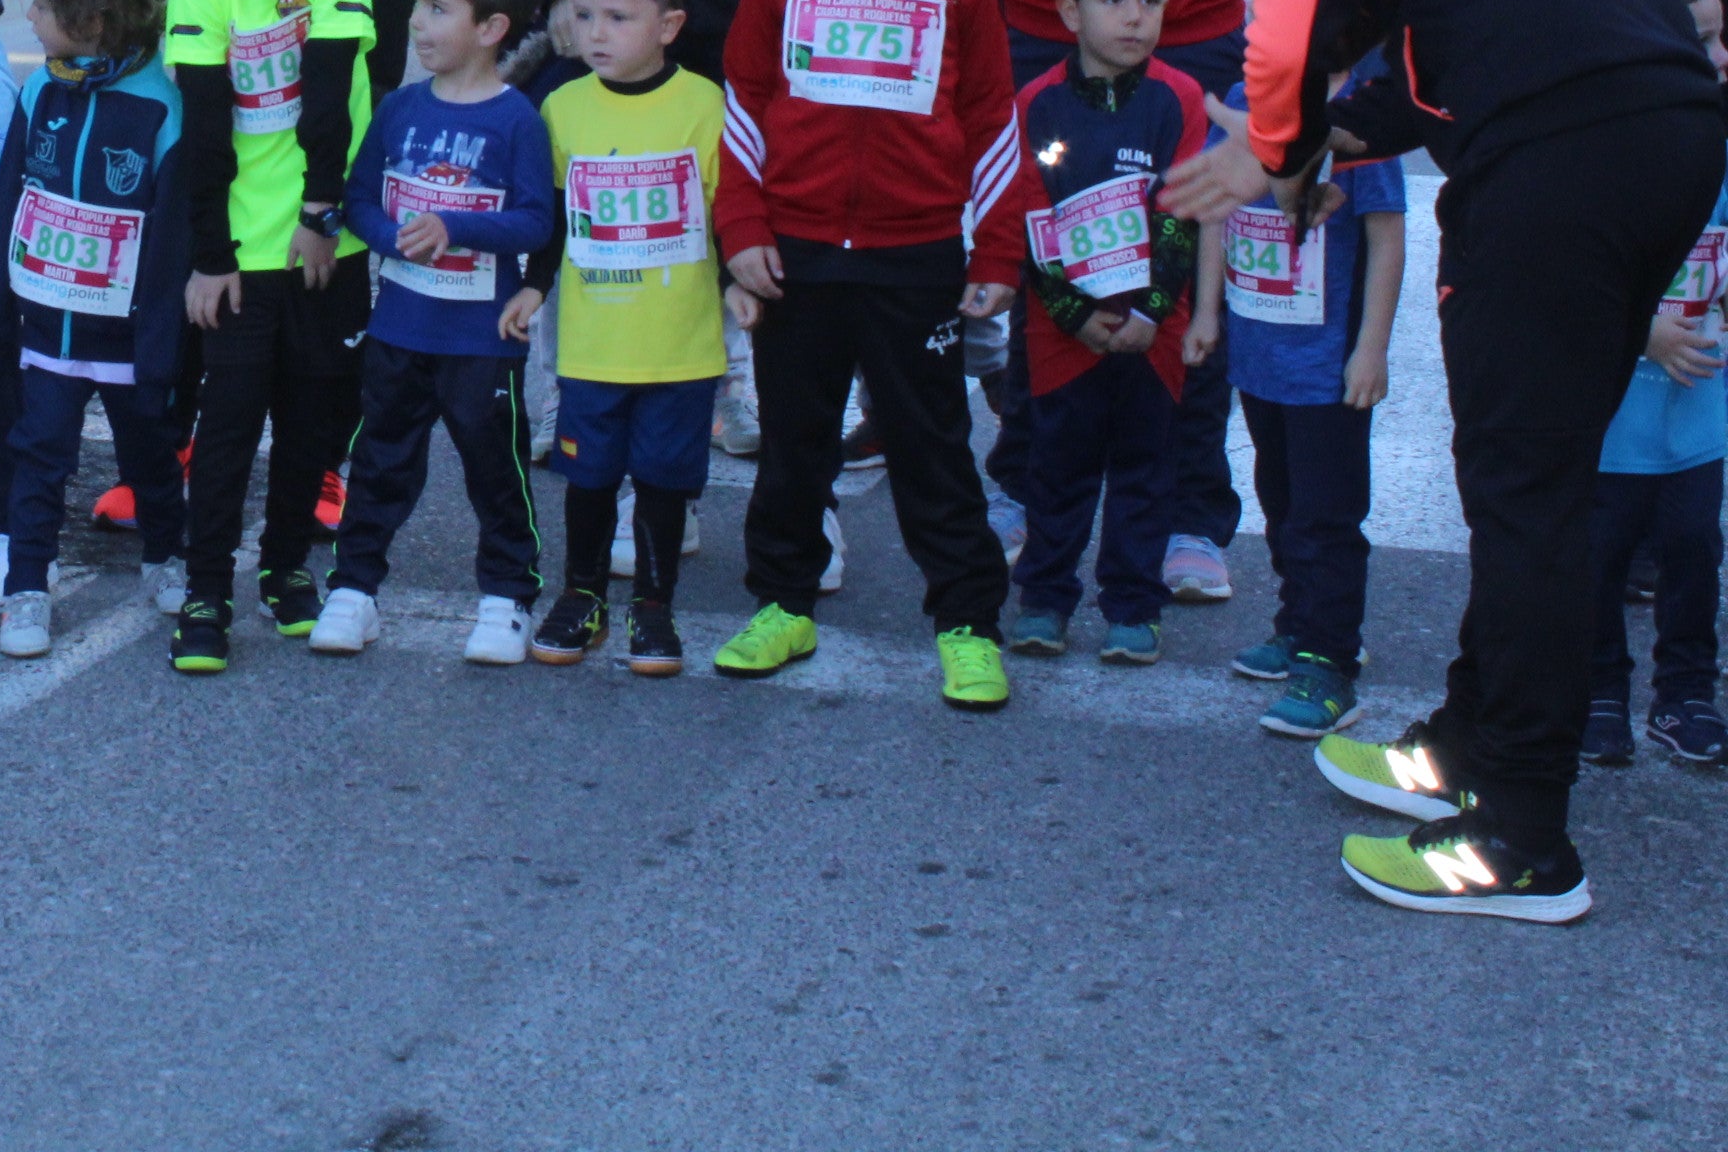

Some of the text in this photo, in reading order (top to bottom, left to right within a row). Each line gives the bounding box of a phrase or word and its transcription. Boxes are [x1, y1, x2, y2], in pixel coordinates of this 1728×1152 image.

[814, 7, 911, 24] CIUDAD DE ROQUETAS
[875, 0, 917, 13] POPULAR
[826, 21, 903, 60] 875
[236, 50, 300, 92] 819
[805, 74, 914, 97] meetingpoint
[597, 162, 635, 175] CARRERA
[638, 159, 677, 174] POPULAR
[585, 171, 673, 187] CIUDAD DE ROQUETAS
[407, 185, 439, 202] CARRERA
[440, 191, 477, 205] POPULAR
[597, 188, 669, 223] 818
[66, 218, 111, 237] ROQUETAS
[77, 208, 117, 226] POPULAR
[1070, 209, 1143, 258] 839
[35, 224, 100, 269] 803
[1087, 249, 1138, 273] FRANCISCO
